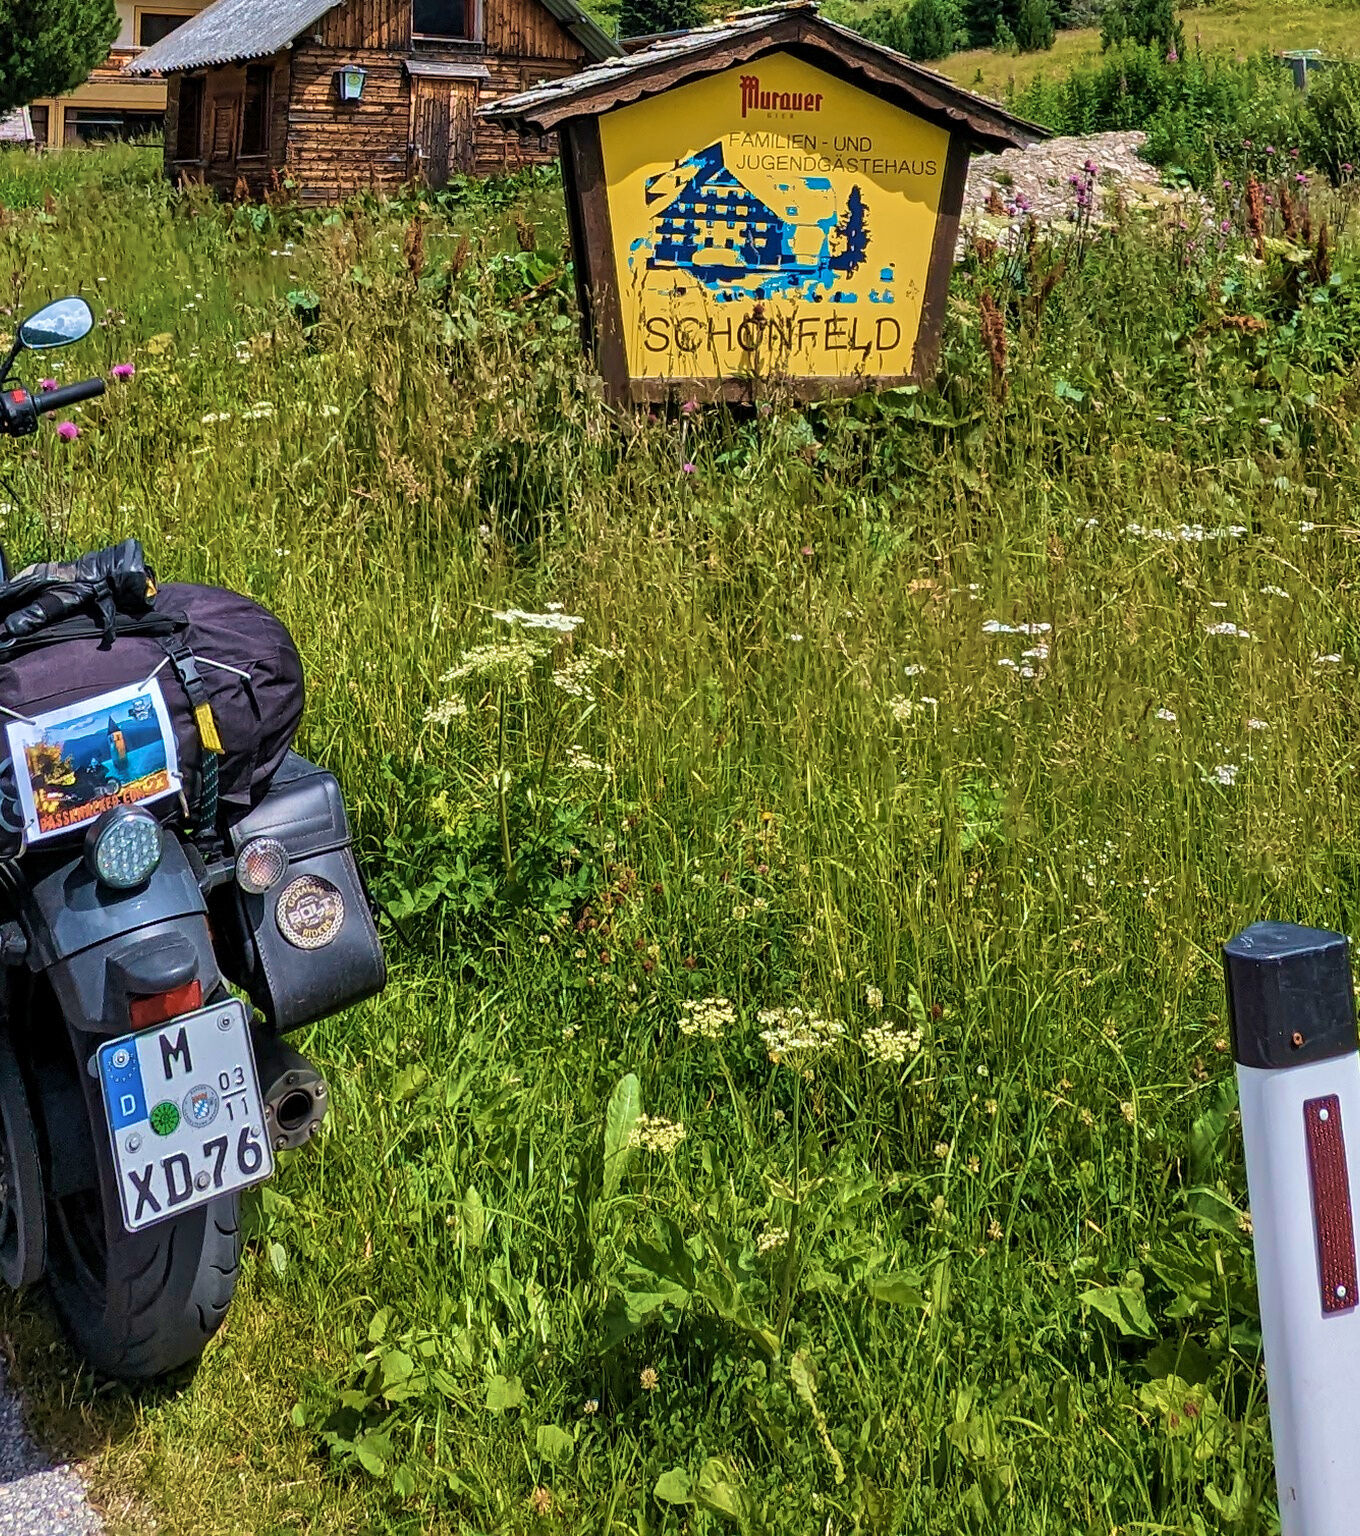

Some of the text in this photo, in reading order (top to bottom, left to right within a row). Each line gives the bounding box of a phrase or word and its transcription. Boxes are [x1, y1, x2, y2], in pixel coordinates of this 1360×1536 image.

[739, 75, 823, 118] Murauer
[729, 132, 816, 150] FAMILIEN
[834, 136, 872, 152] UND
[736, 154, 937, 175] JUGENDGÄSTEHAUS
[159, 1027, 193, 1081] M
[218, 1066, 245, 1091] 03
[120, 1093, 136, 1117] D
[225, 1096, 249, 1121] 11
